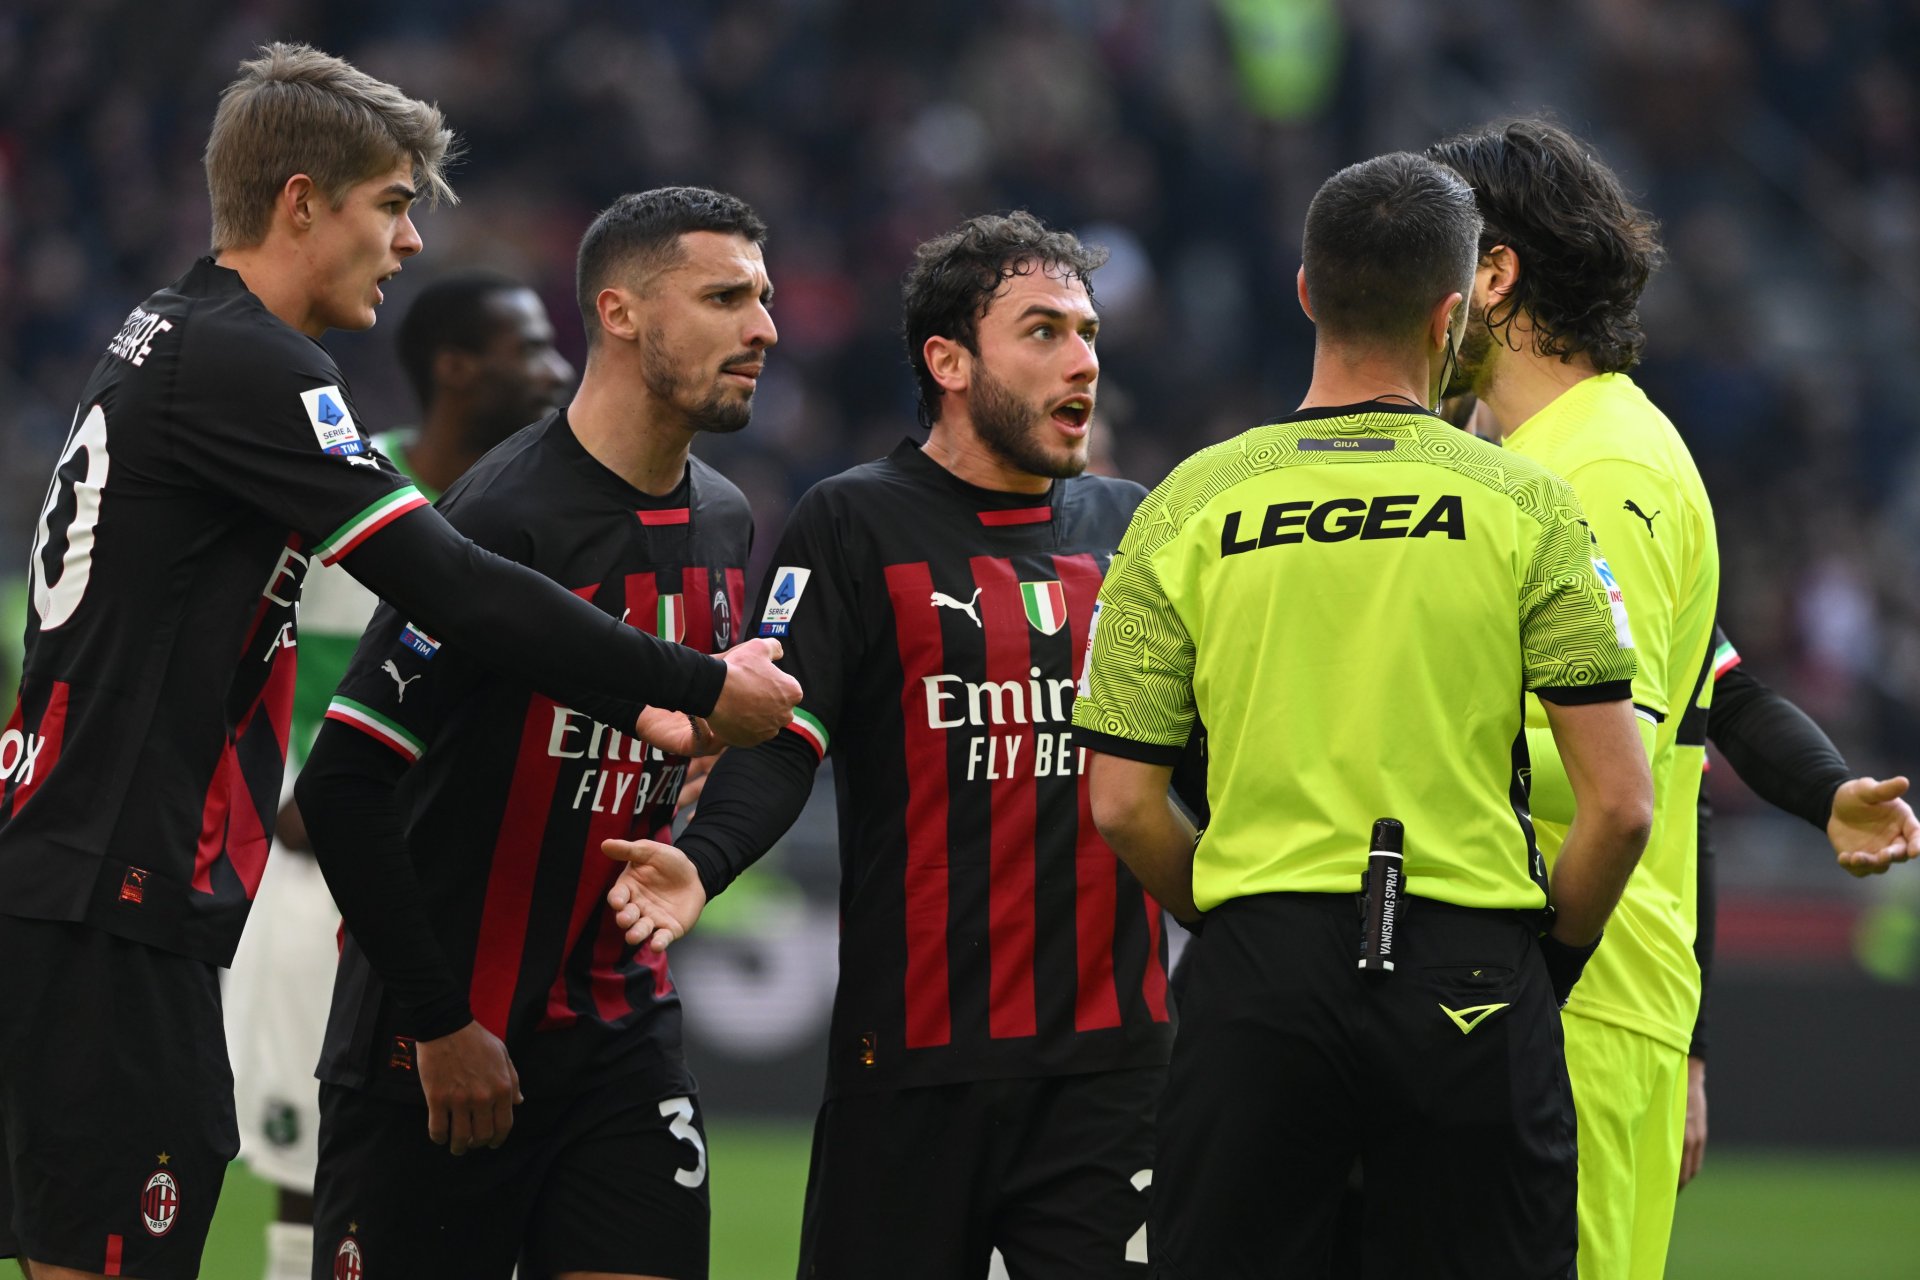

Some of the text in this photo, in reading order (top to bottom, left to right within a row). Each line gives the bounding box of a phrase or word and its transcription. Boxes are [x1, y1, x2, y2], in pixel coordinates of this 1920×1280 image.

[323, 428, 346, 440] SERIE
[340, 442, 360, 454] TIM
[1332, 440, 1360, 449] GIUA
[1220, 494, 1466, 559] LEGEA
[771, 624, 786, 634] TIM
[413, 638, 432, 656] TIM
[921, 666, 1081, 730] Emir
[966, 734, 1023, 781] FLY
[572, 769, 635, 815] FLY
[1380, 866, 1399, 955] VANISHING SPRAY
[150, 1174, 174, 1188] ACM
[149, 1220, 168, 1229] 1899
